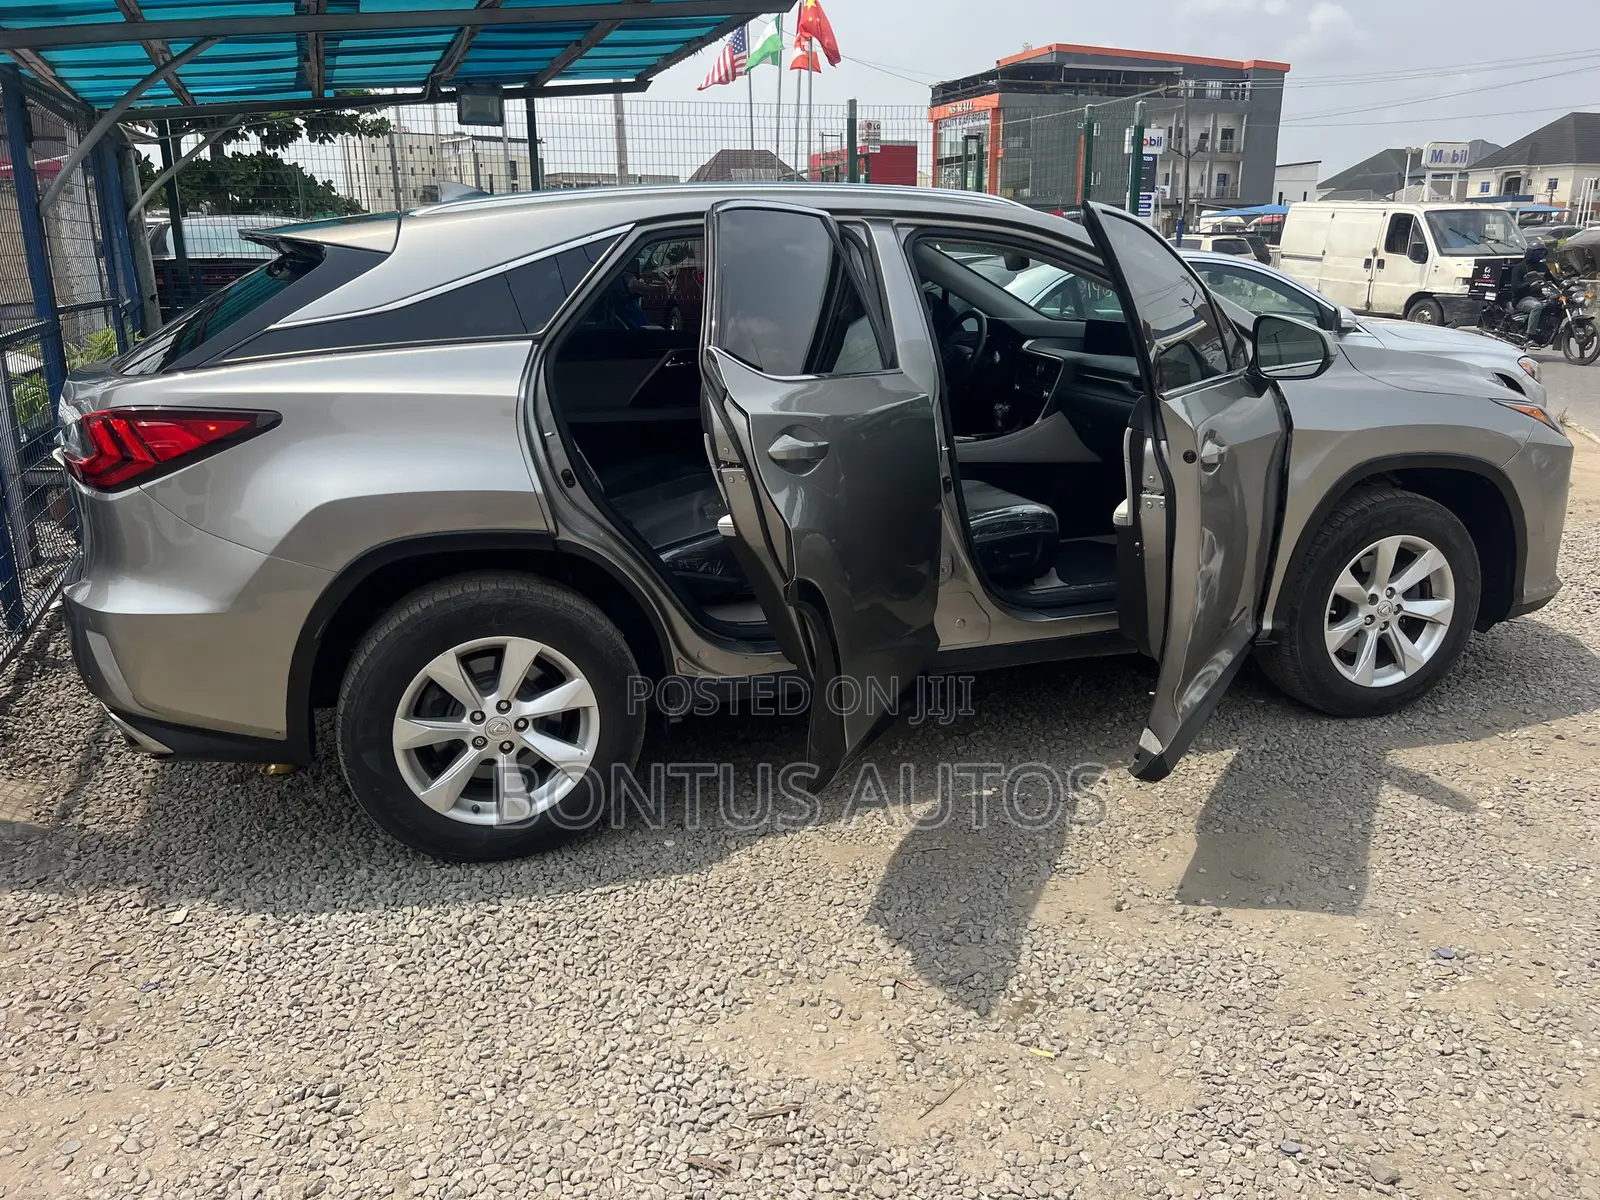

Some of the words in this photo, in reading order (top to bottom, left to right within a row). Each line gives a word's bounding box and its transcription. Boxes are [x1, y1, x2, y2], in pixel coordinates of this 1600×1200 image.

[957, 101, 974, 112] MALL
[1143, 136, 1163, 147] obil
[1430, 149, 1469, 164] Mobil
